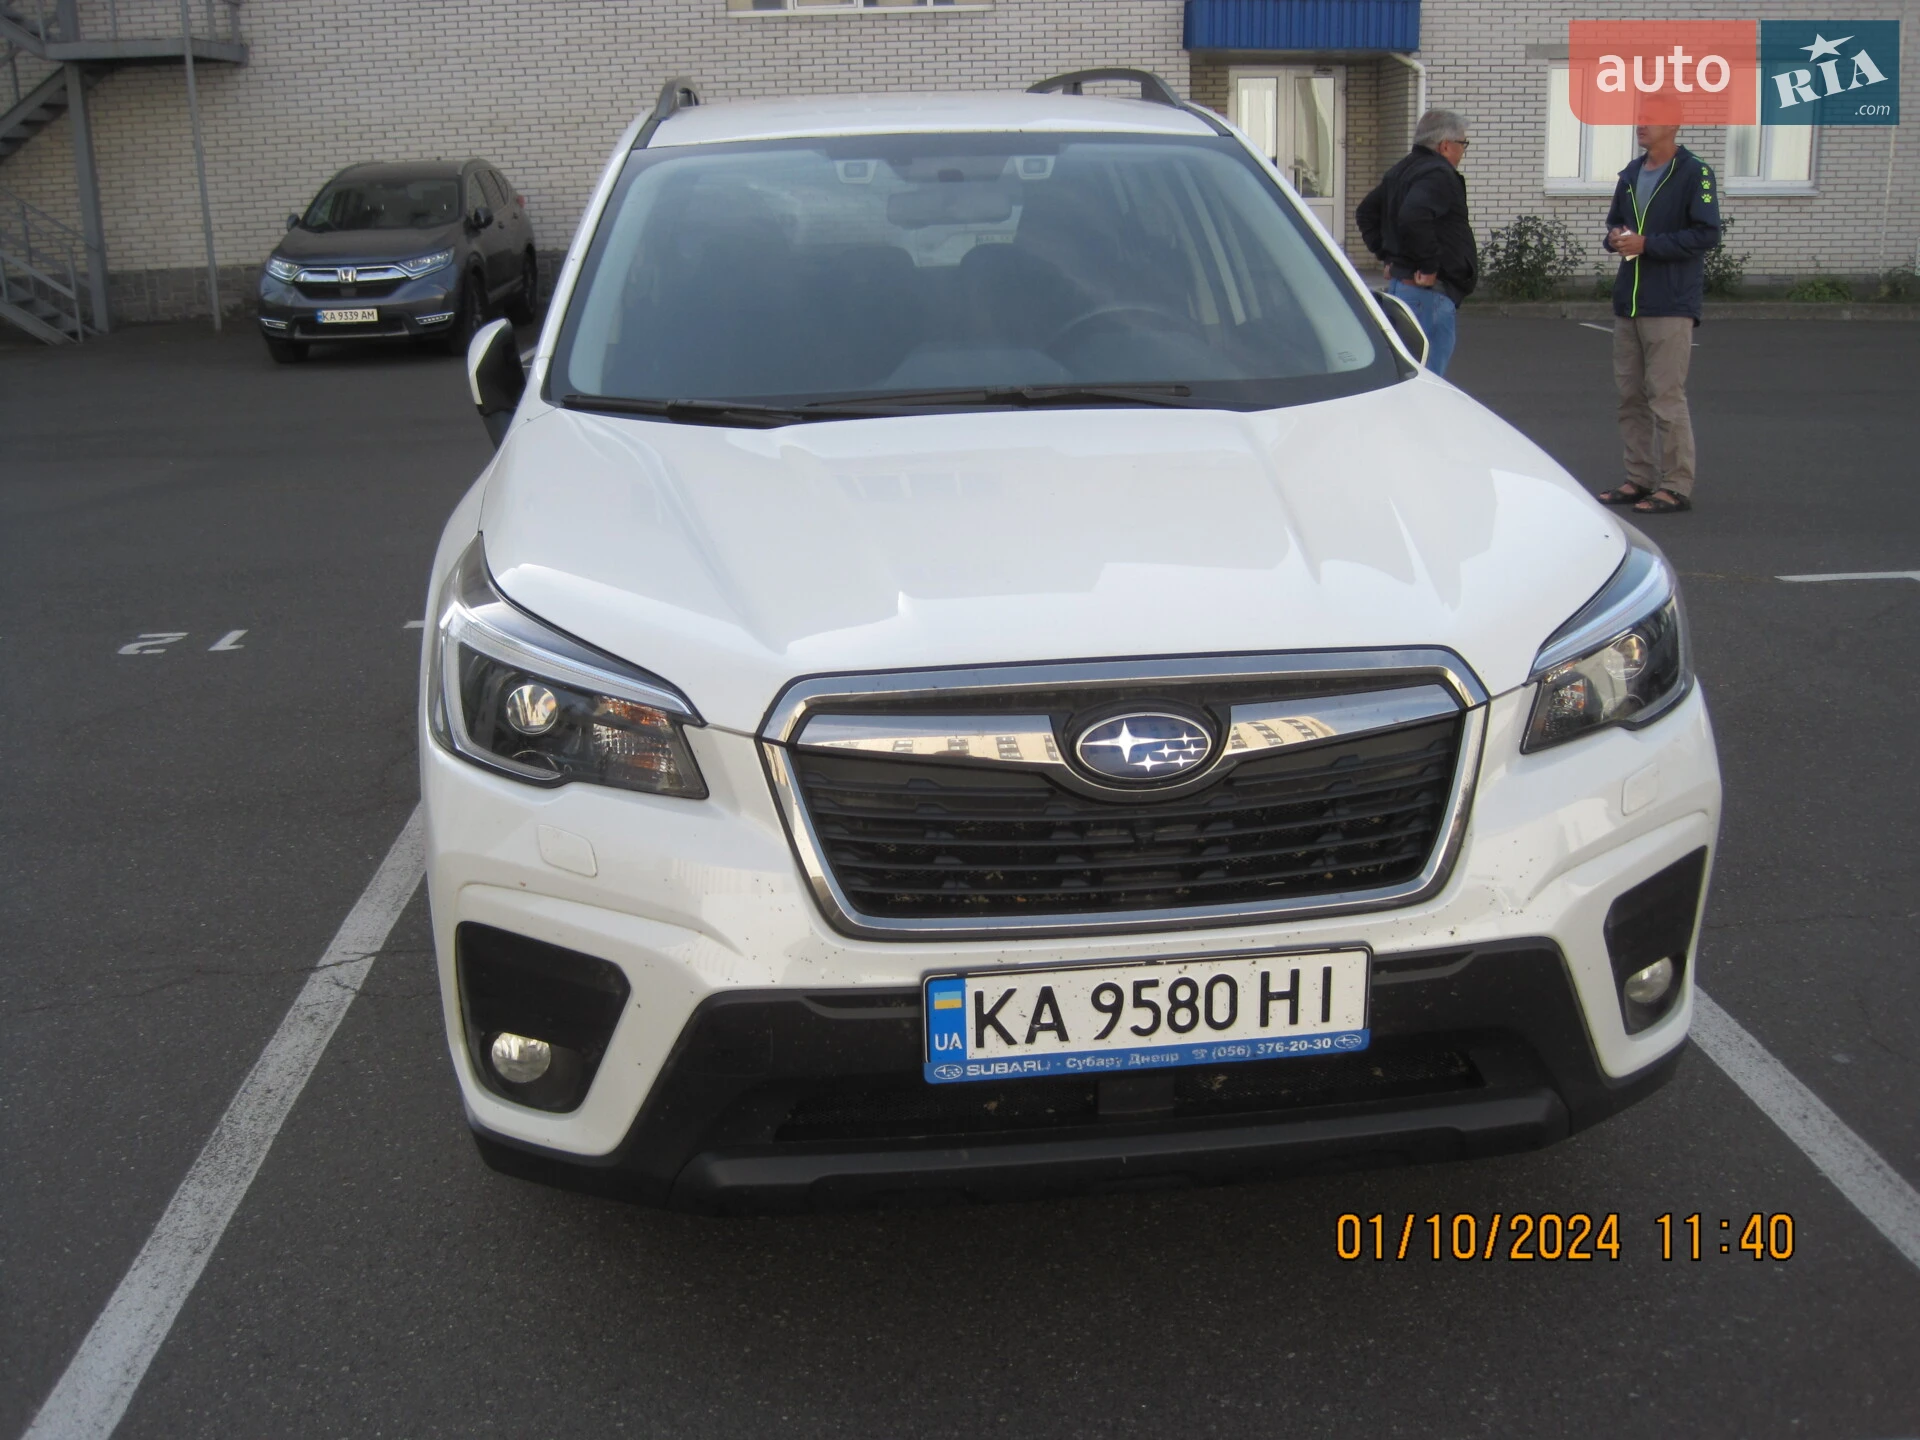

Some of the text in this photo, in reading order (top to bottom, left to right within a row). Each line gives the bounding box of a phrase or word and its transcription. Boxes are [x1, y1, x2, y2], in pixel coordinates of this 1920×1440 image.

[322, 310, 375, 321] KA 9339 AM
[973, 965, 1333, 1049] KA 9580 HI
[934, 1033, 963, 1051] UA
[1256, 1037, 1332, 1055] 376-20-30
